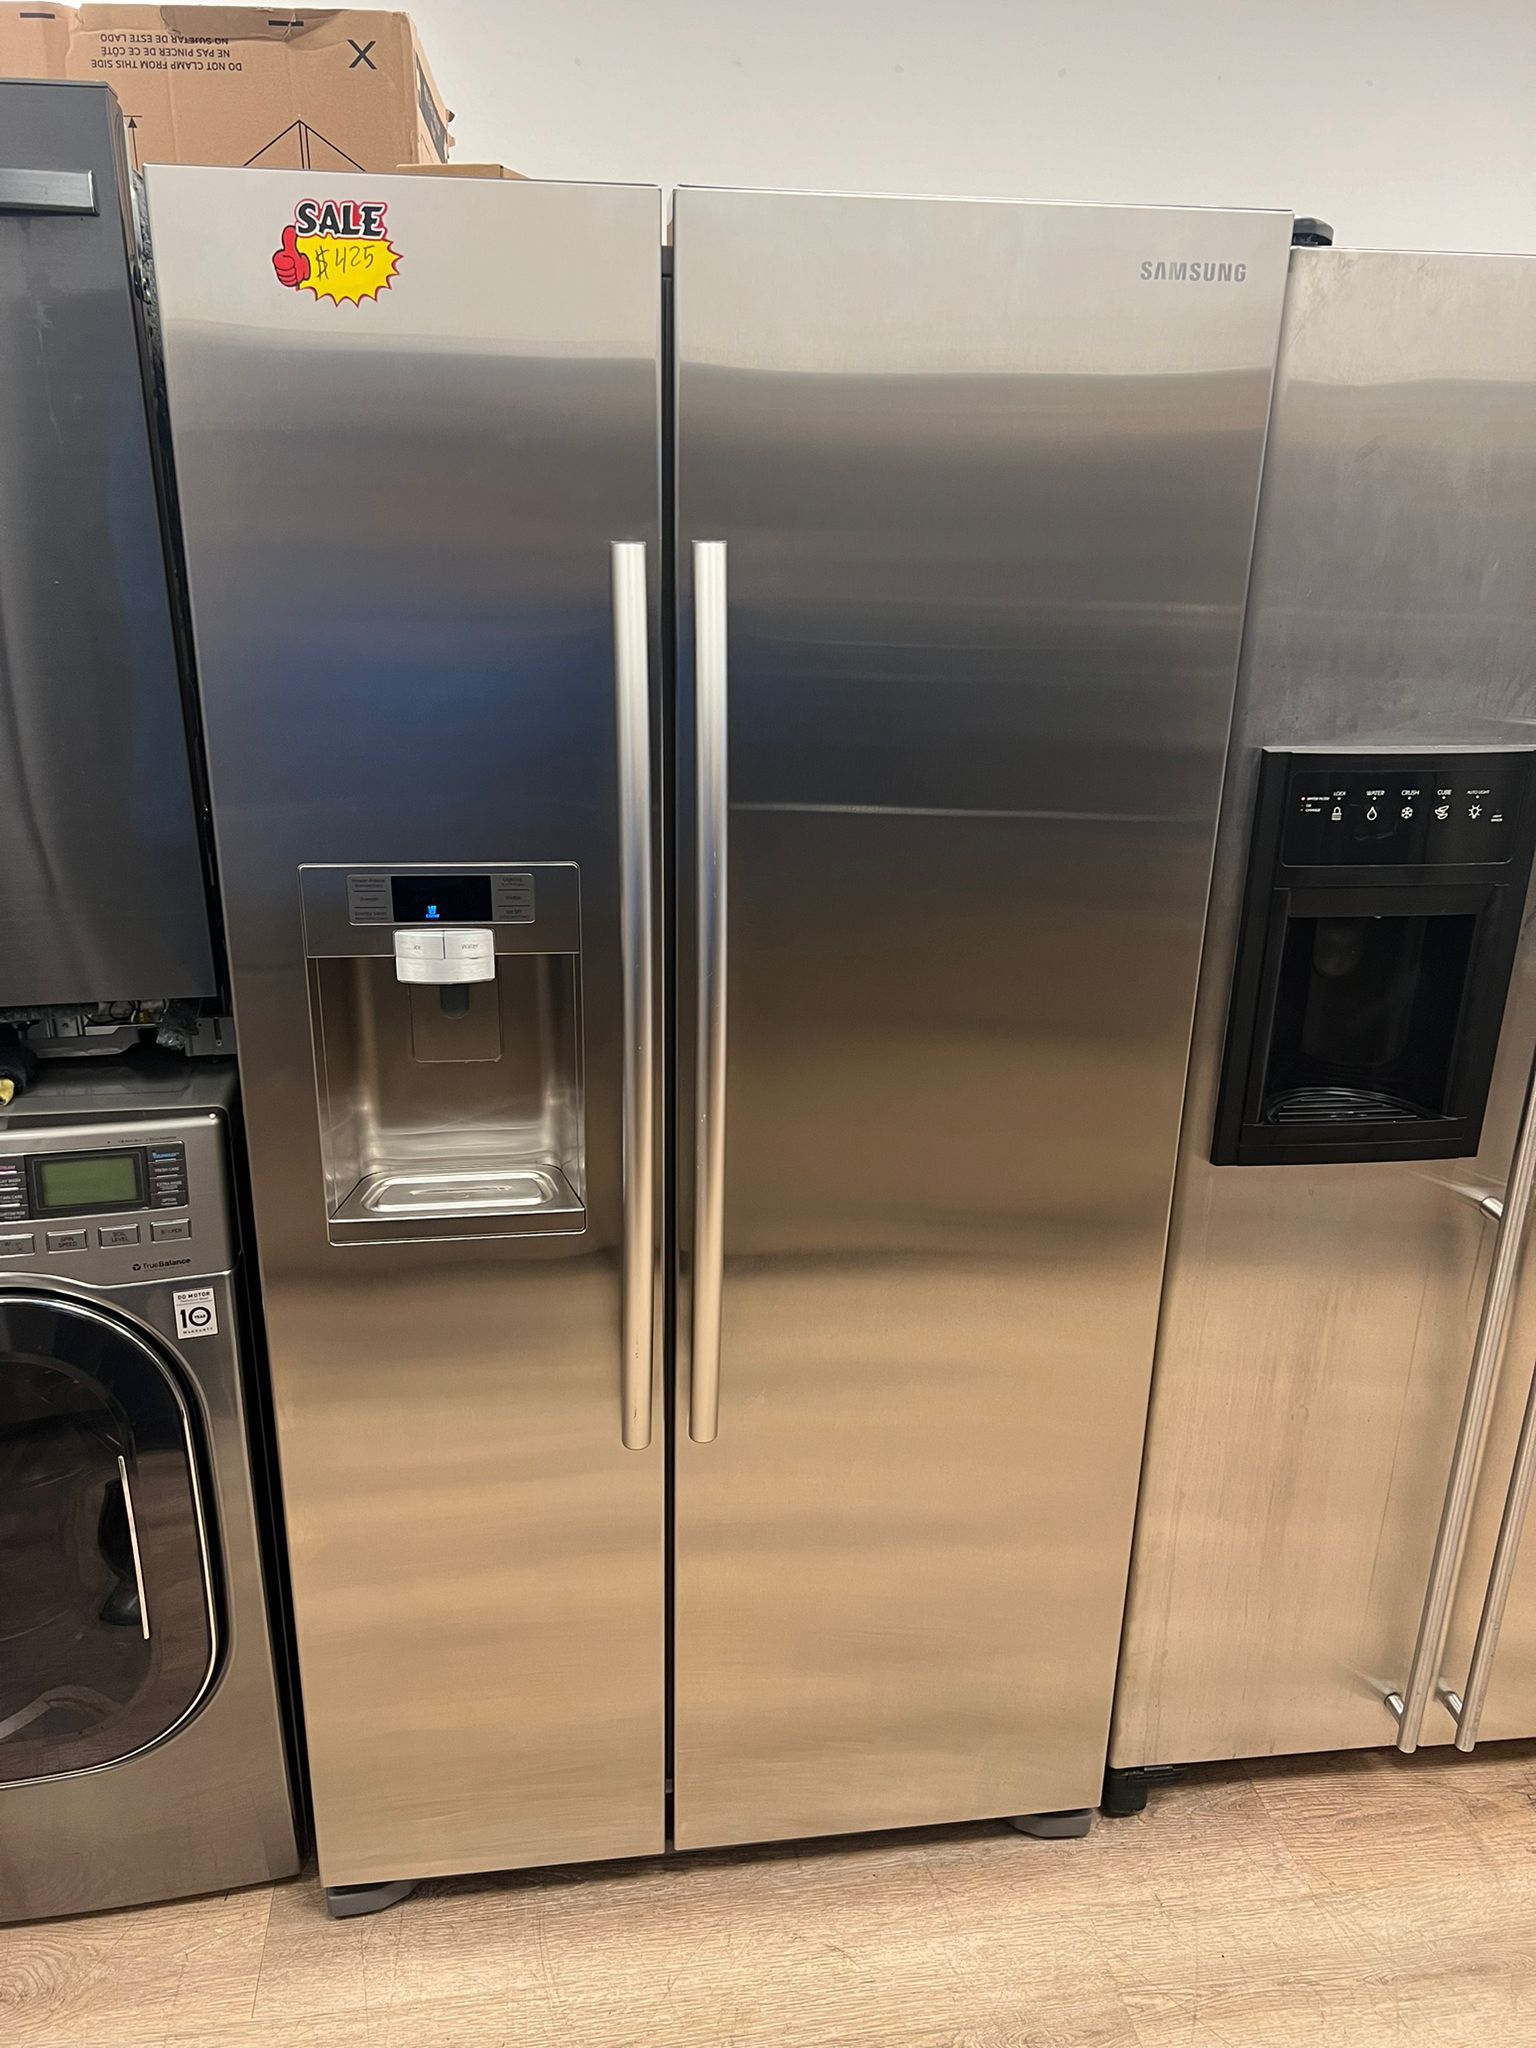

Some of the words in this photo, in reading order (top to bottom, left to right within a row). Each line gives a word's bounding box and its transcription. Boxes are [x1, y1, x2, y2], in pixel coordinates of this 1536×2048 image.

[100, 33, 127, 42] LADO
[129, 34, 153, 43] ESTE
[155, 34, 168, 44] DE
[214, 37, 229, 45] NO
[100, 46, 126, 58] CÔTÉ
[128, 47, 141, 56] CE
[143, 47, 157, 56] DE
[159, 47, 194, 57] PINCER
[196, 48, 215, 58] PAS
[217, 49, 231, 58] NE
[91, 59, 113, 69] SIDE
[116, 59, 138, 69] THIS
[140, 60, 168, 70] FROM
[170, 60, 204, 71] CLAMP
[206, 61, 226, 71] NOT
[228, 62, 242, 72] DO
[296, 201, 386, 238] SALE
[315, 245, 376, 280] $425
[1140, 260, 1247, 283] SAMSUNG
[143, 1258, 191, 1270] TrueBalance
[188, 1291, 211, 1299] MOTOR
[180, 1306, 212, 1329] 10
